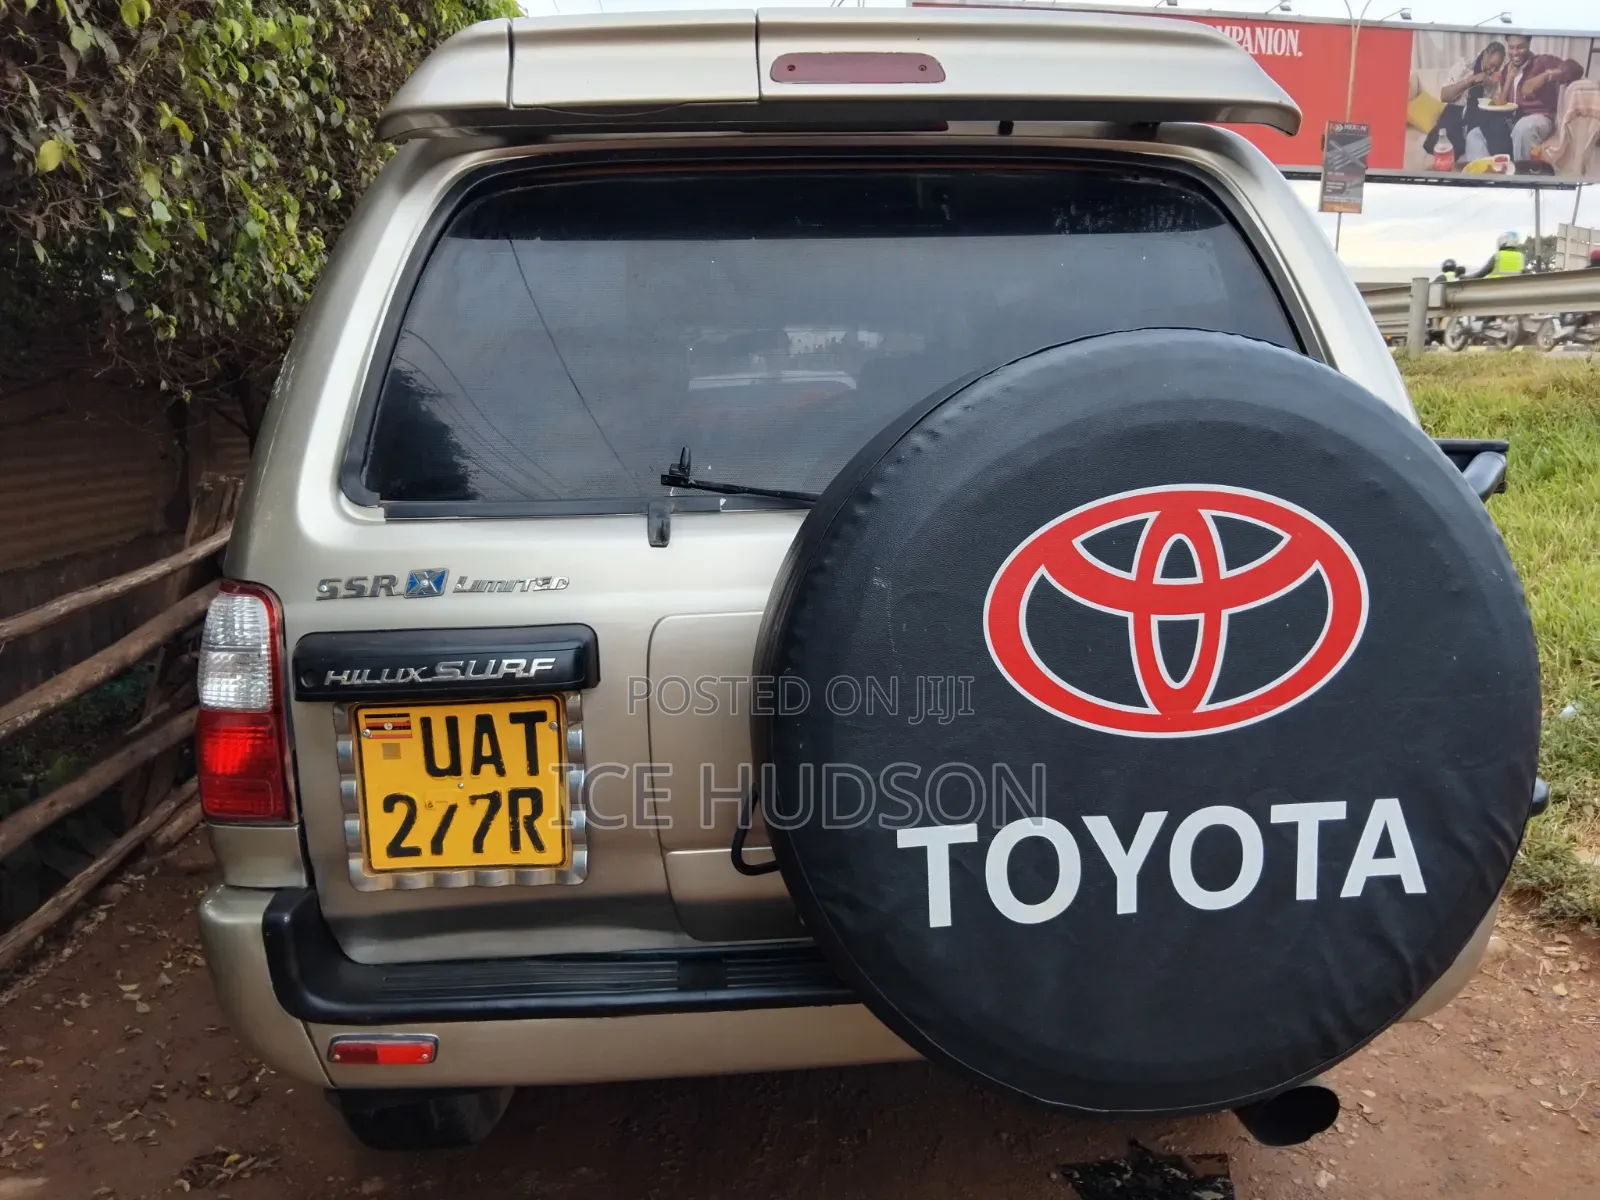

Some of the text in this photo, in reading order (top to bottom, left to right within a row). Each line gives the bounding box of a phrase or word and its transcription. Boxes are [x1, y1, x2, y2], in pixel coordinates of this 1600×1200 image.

[323, 657, 556, 686] HILUX SURF
[419, 710, 548, 778] UAT
[383, 786, 547, 858] 277R
[896, 798, 1427, 928] TOYOTA
